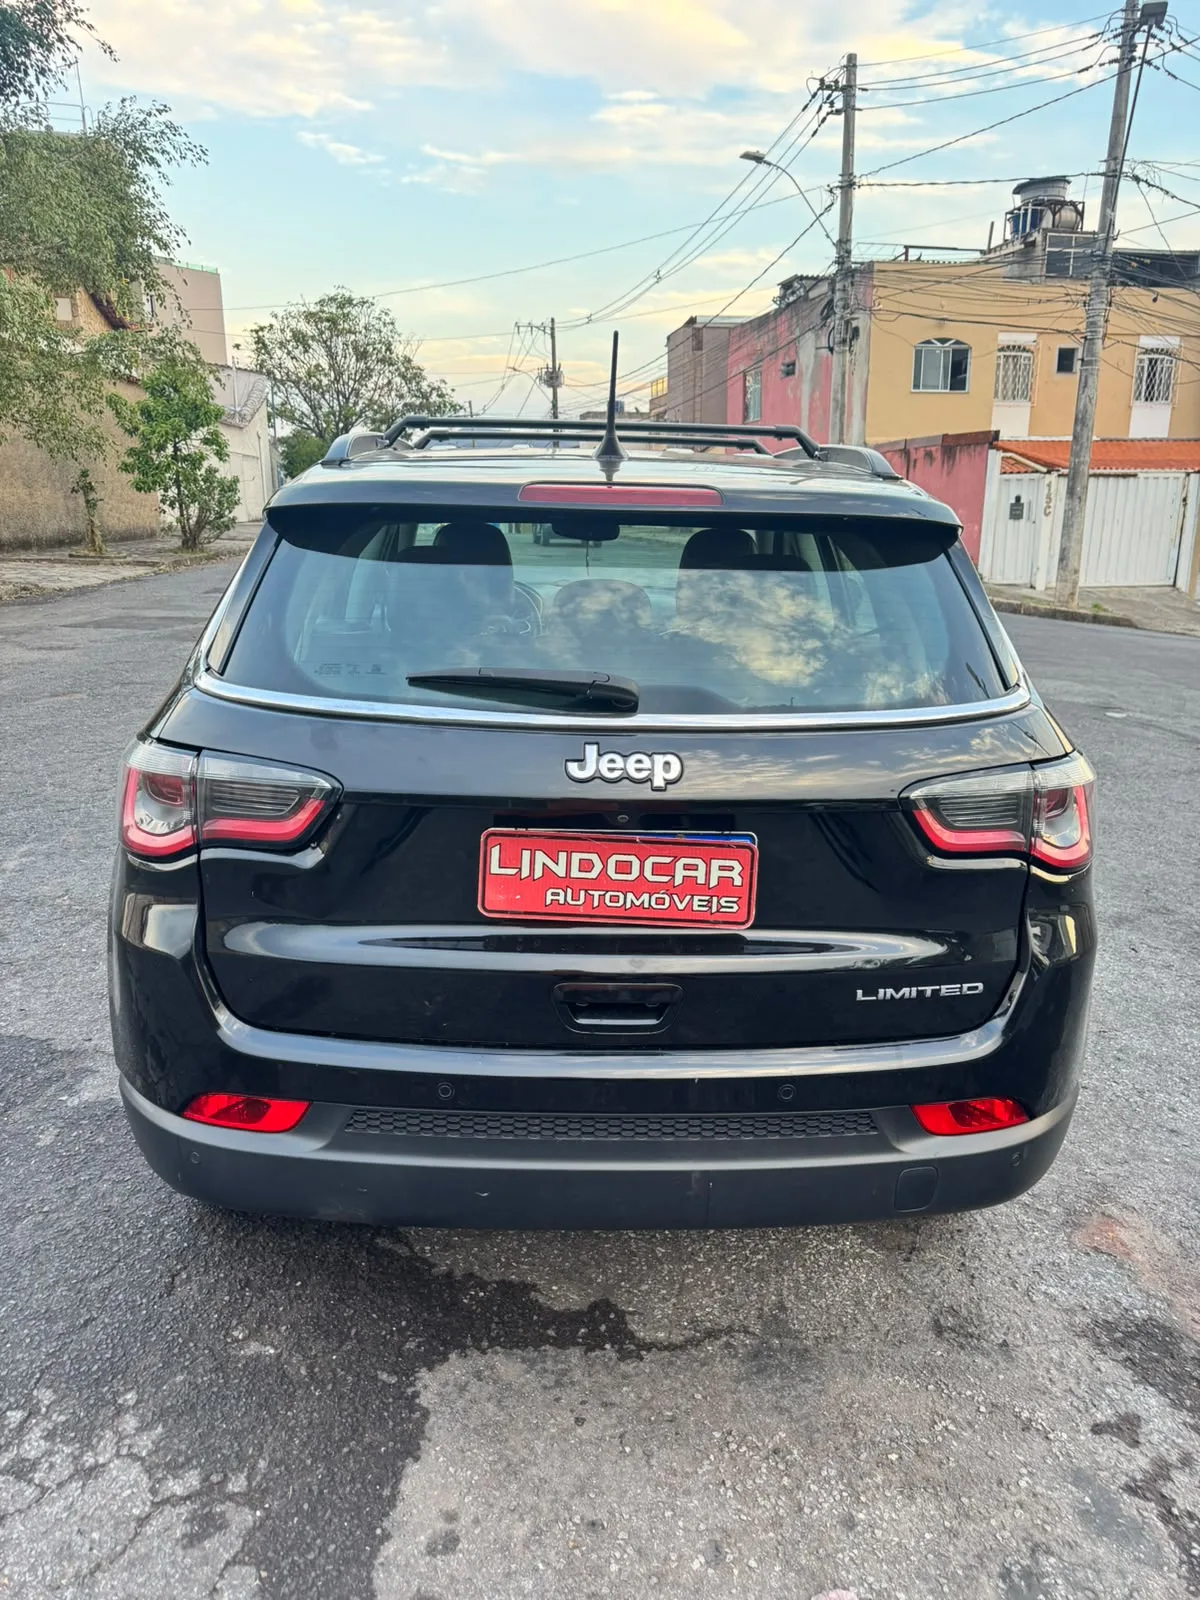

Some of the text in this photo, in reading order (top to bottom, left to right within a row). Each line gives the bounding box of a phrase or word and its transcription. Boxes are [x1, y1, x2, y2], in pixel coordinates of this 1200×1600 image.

[565, 742, 683, 791] Jeep
[489, 844, 743, 889] LINDOCAR
[544, 887, 740, 914] AUTOMÓVEIS
[856, 982, 984, 1001] LIMITED
